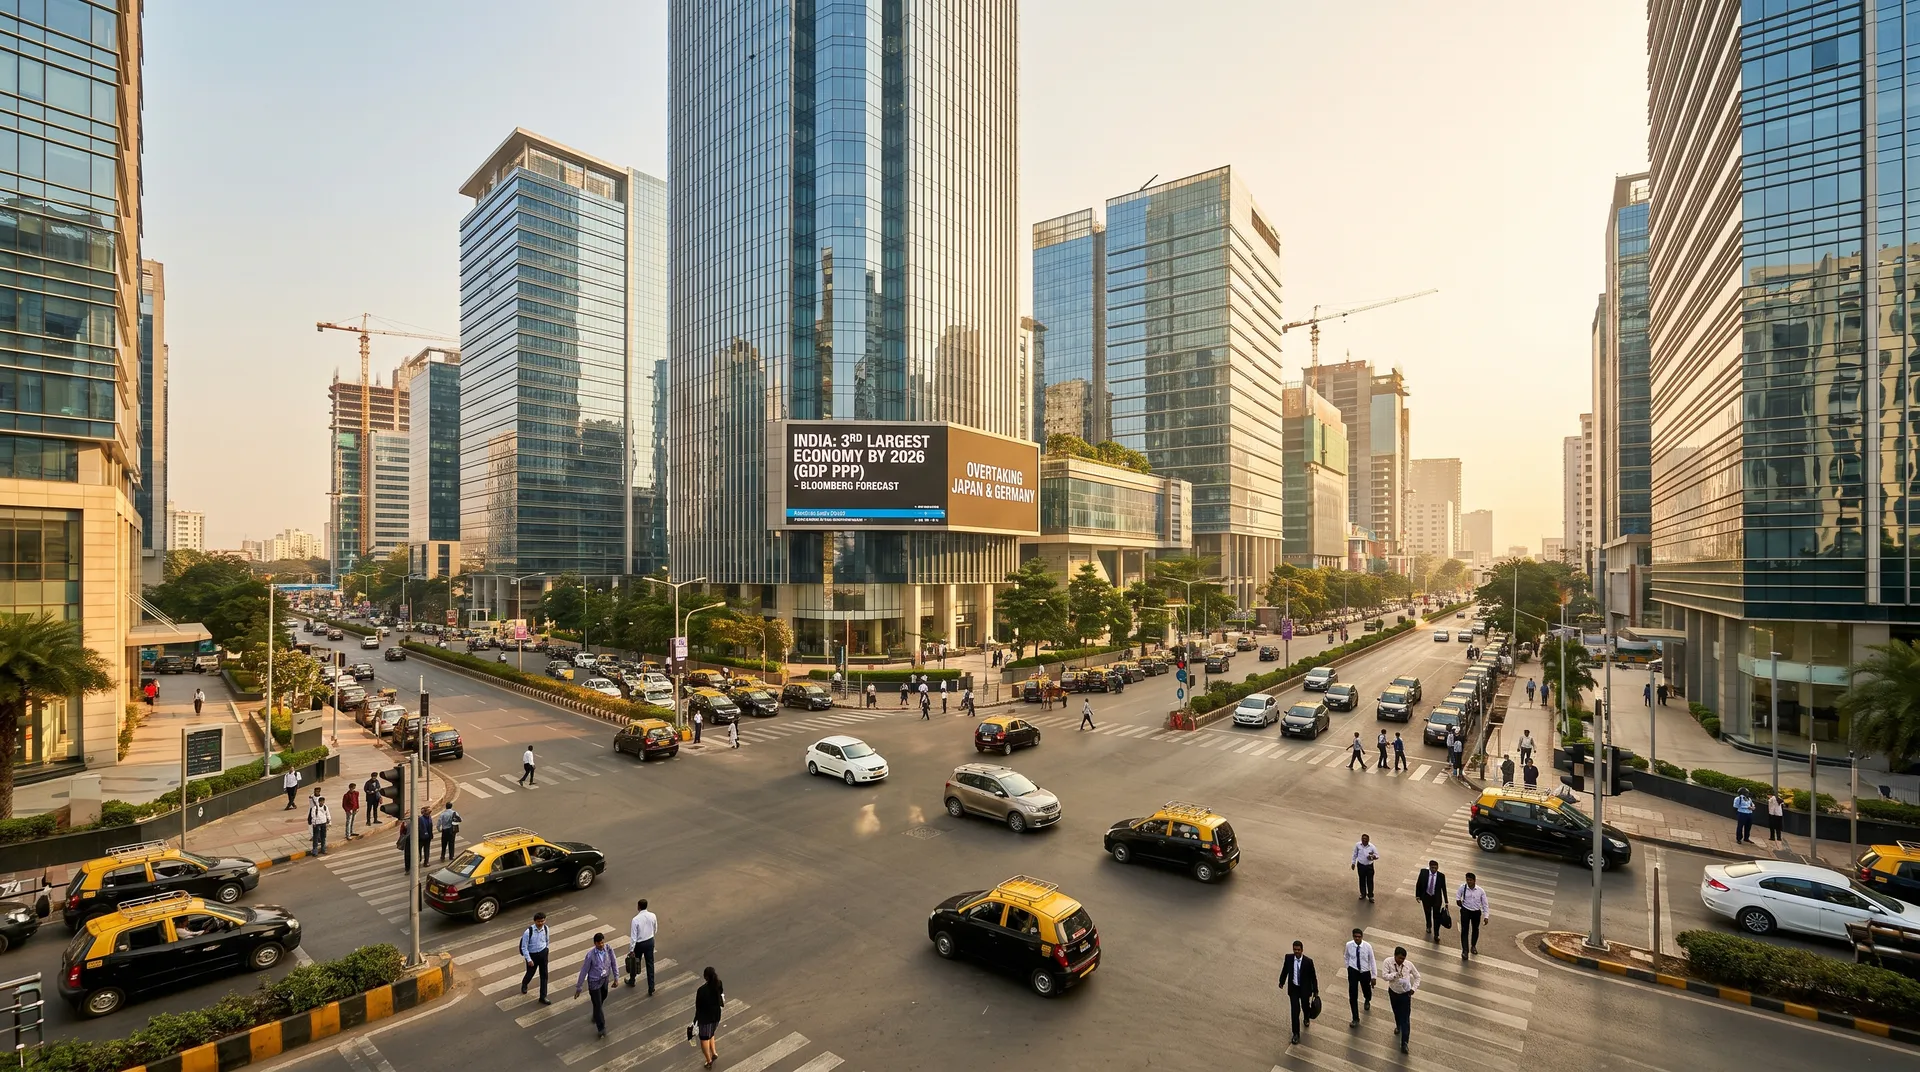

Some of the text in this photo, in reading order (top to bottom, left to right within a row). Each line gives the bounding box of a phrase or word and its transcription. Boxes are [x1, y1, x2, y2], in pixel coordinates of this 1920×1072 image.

[793, 433, 930, 448] INDIA: 3RD LARGEST
[793, 449, 925, 463] ECONOMY BY 2026
[793, 464, 865, 481] (GDP PPP)
[966, 461, 1023, 486] OVERTAKING
[800, 481, 854, 491] BLOOMBERG
[855, 481, 900, 491] FORECAST
[951, 478, 1035, 504] JAPAN & GERMANY
